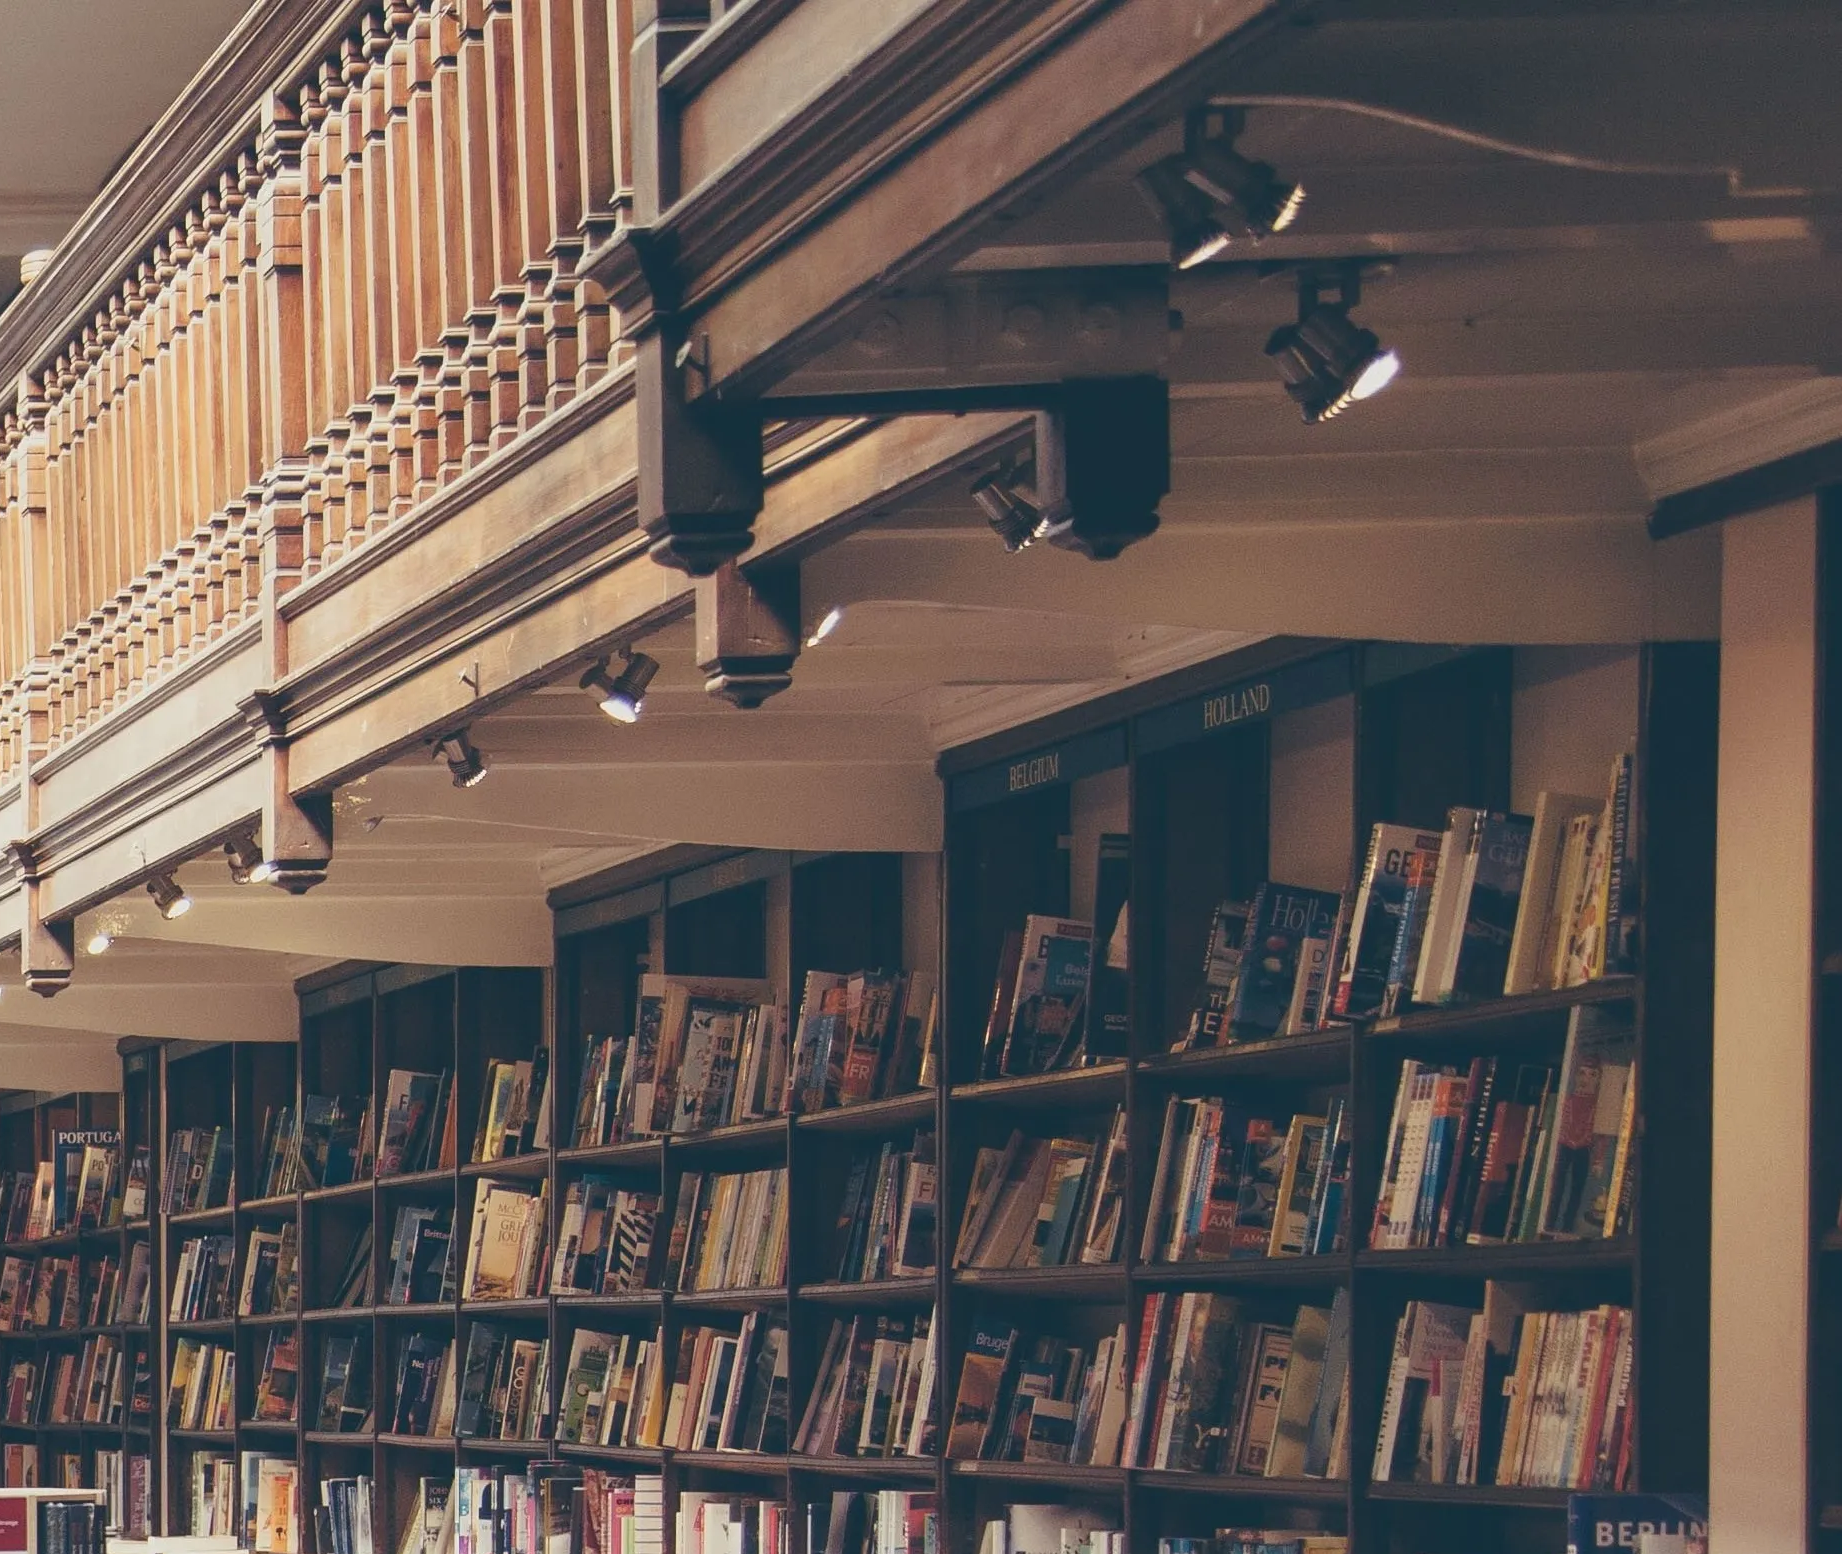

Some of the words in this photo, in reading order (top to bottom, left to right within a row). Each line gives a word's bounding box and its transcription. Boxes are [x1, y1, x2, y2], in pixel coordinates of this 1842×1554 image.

[1204, 684, 1270, 729] HOLLAND
[1009, 753, 1059, 791] BELGIUM
[1481, 1131, 1500, 1181] Berlin
